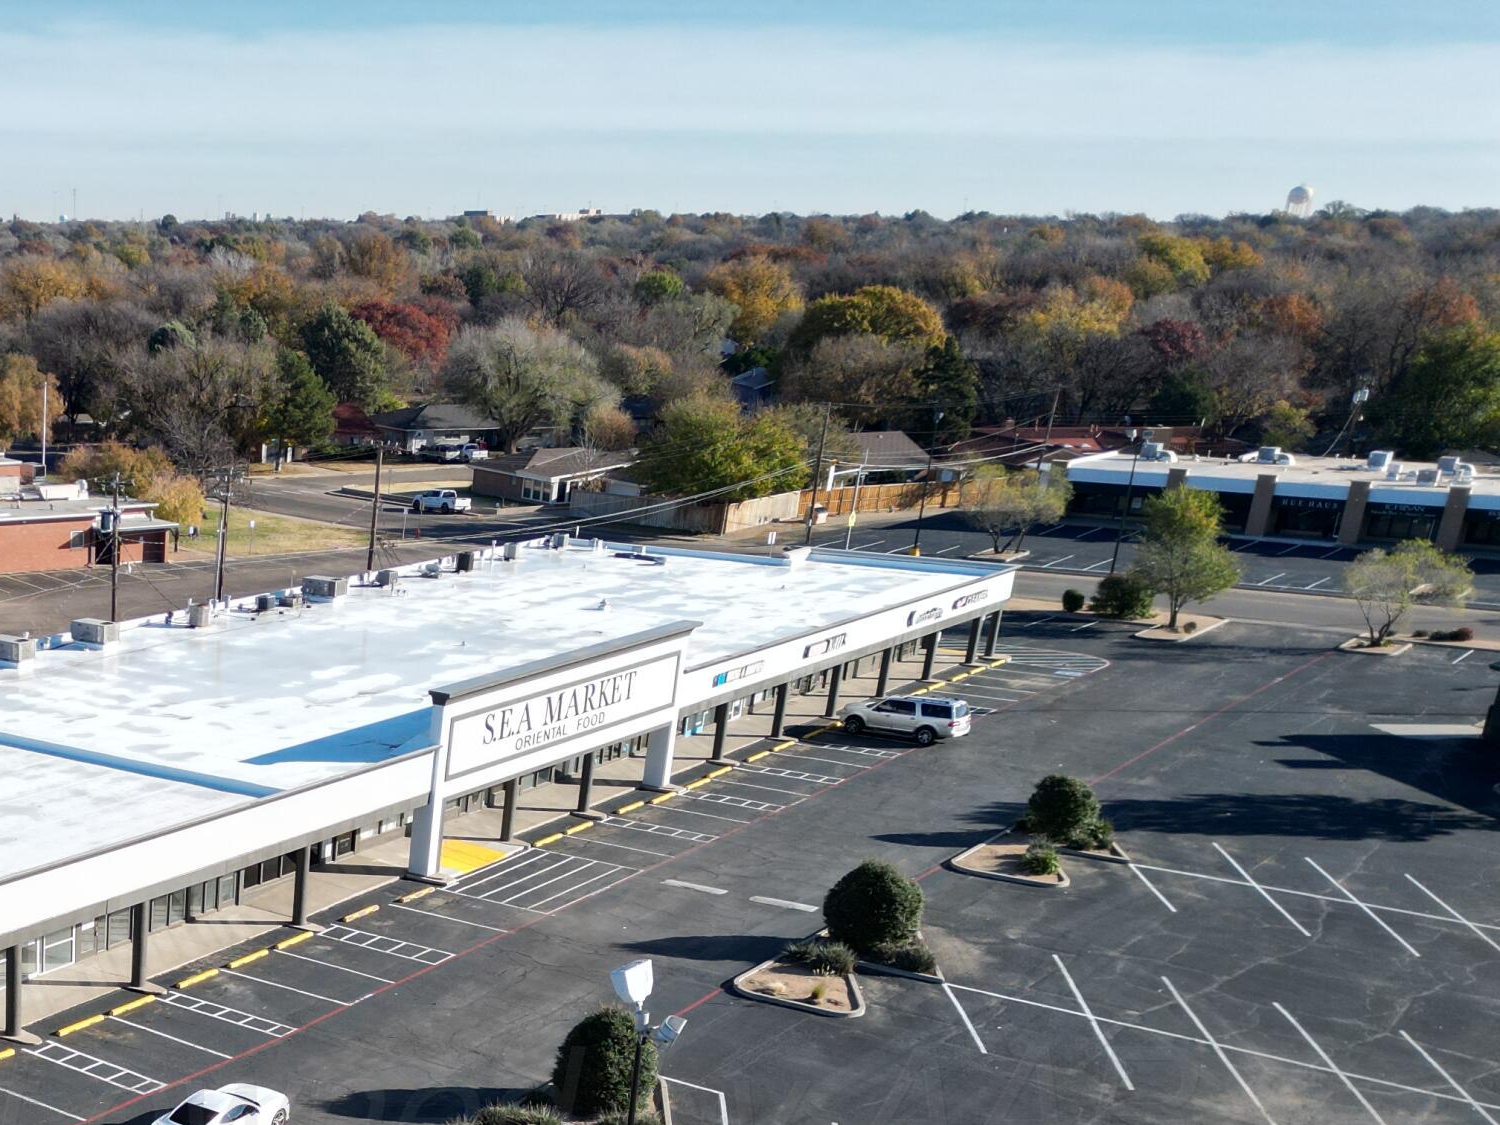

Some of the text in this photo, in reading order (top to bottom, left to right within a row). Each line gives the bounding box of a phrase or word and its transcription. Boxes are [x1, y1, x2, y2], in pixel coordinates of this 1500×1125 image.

[543, 671, 637, 726] MARKET
[516, 712, 605, 751] ORIENTAL FOOD
